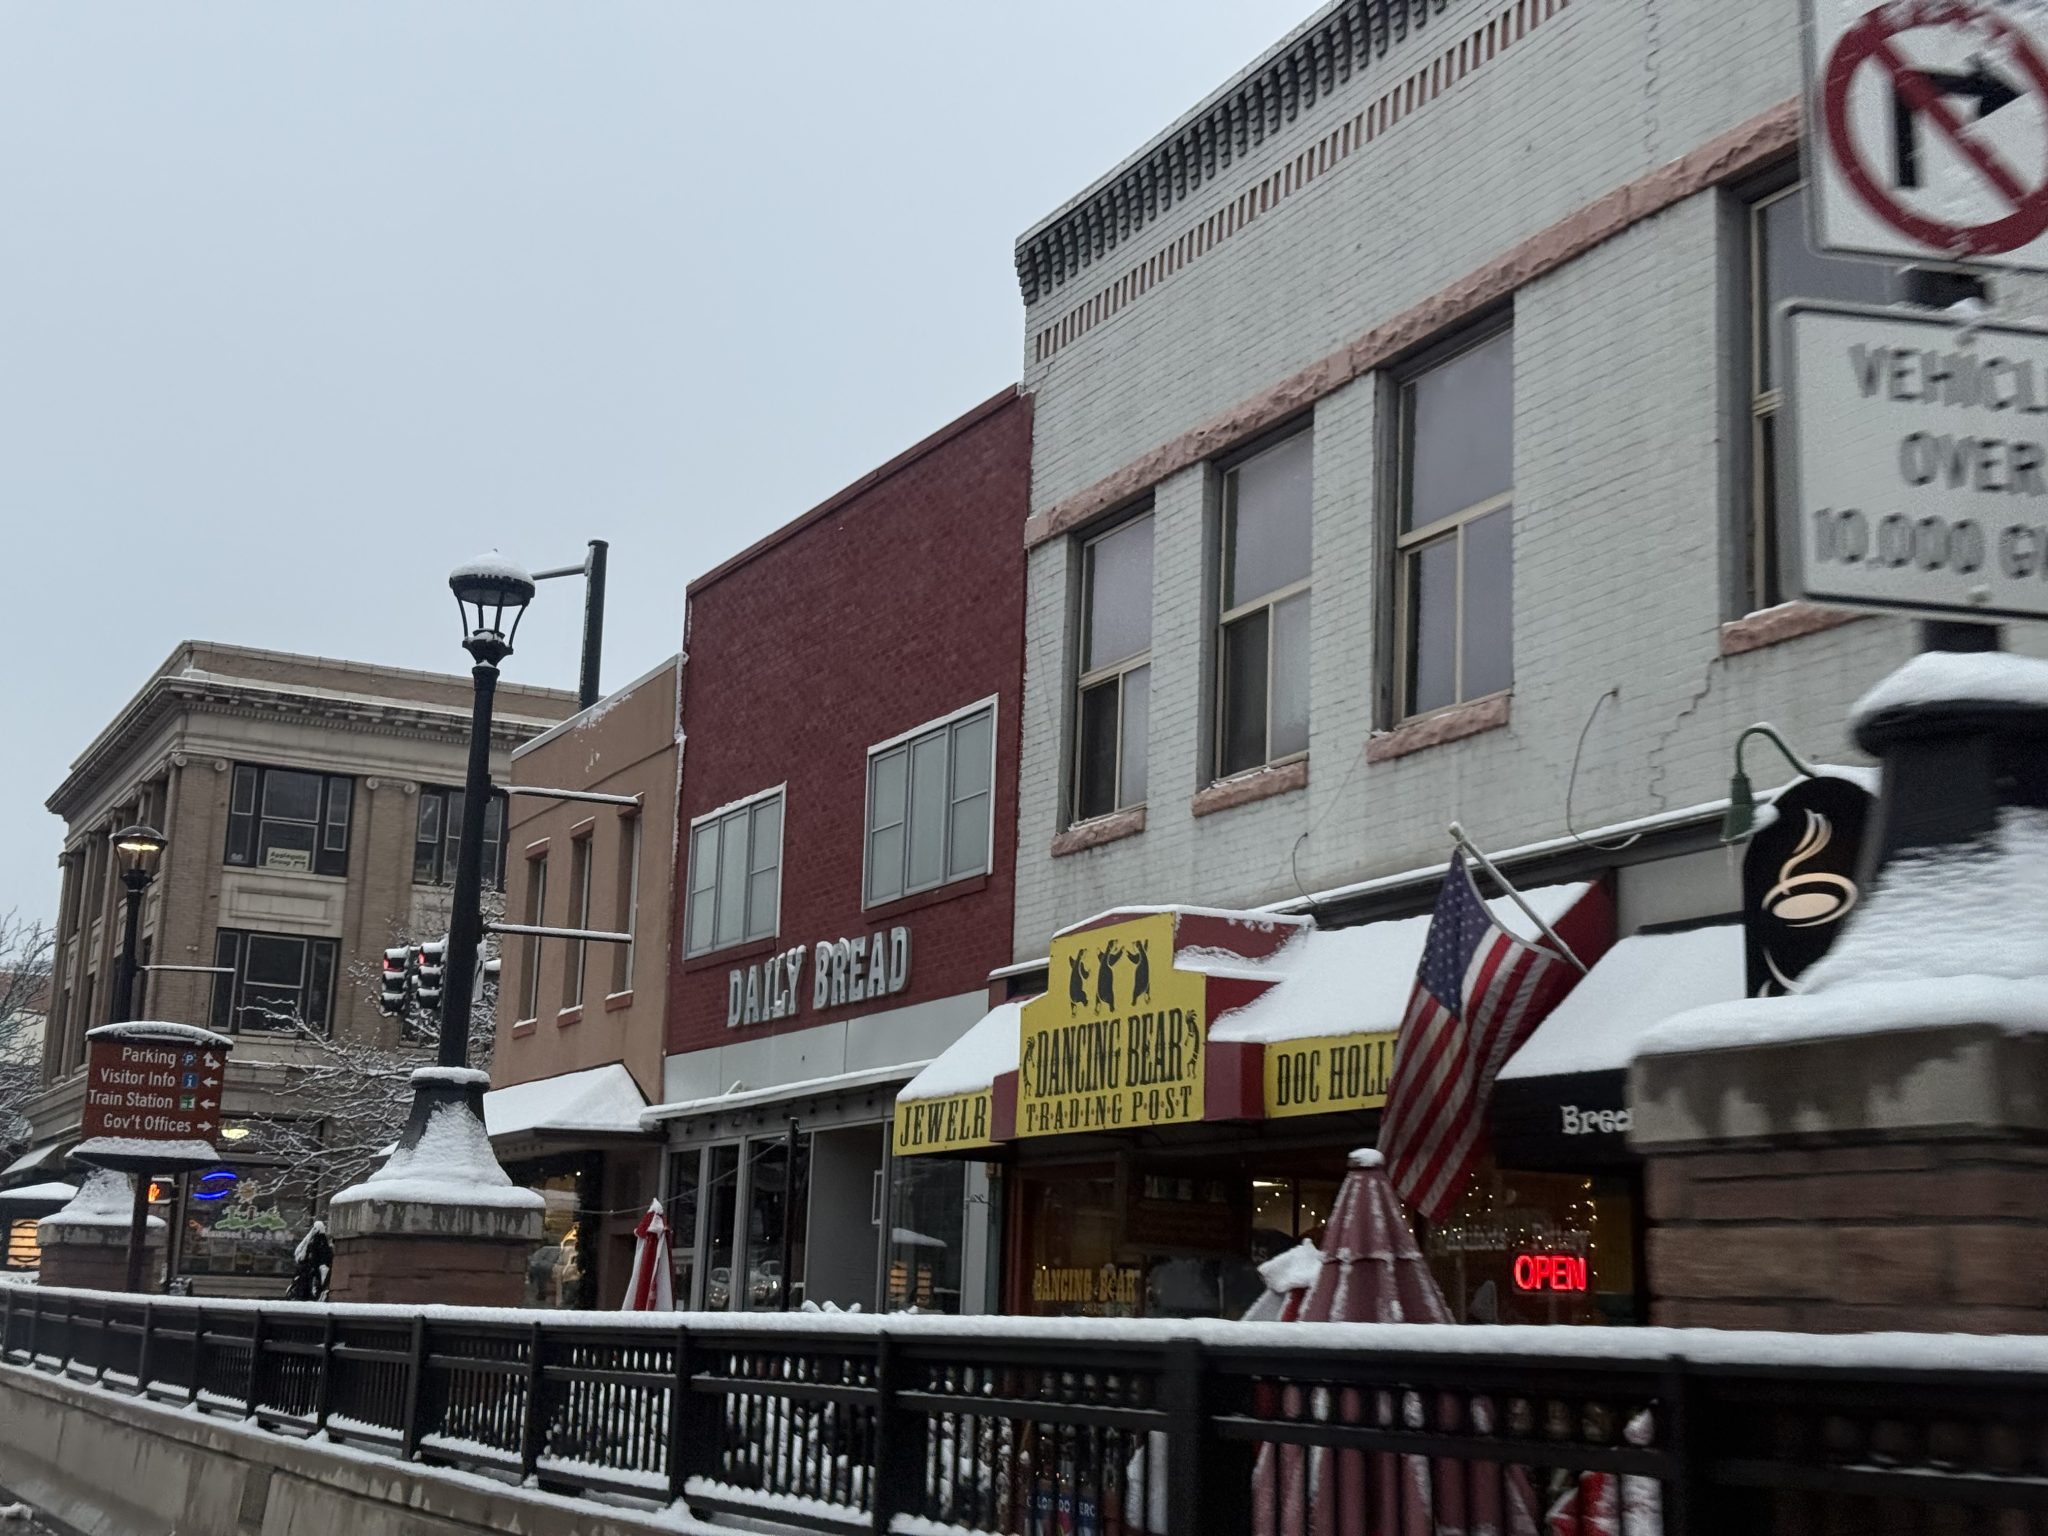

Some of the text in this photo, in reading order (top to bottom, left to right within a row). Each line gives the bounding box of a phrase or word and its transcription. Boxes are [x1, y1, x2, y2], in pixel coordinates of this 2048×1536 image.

[1847, 343, 2048, 414] VEHICL
[1899, 431, 2047, 498] OVER
[1999, 522, 2048, 582] G
[727, 926, 910, 1028] DAILY BREAD
[122, 1047, 177, 1068] Parking
[1035, 1007, 1183, 1098] DANCING BEAR
[89, 1089, 173, 1109] Train Station
[101, 1068, 145, 1085] Visitor
[148, 1071, 176, 1087] Info
[1277, 1050, 1320, 1105] DOC
[103, 1113, 191, 1132] Gov't Offices
[900, 1096, 992, 1147] JEWELR
[1560, 1104, 1633, 1135] Brea
[1034, 1268, 1092, 1301] DANCING
[1514, 1255, 1586, 1291] OPEN
